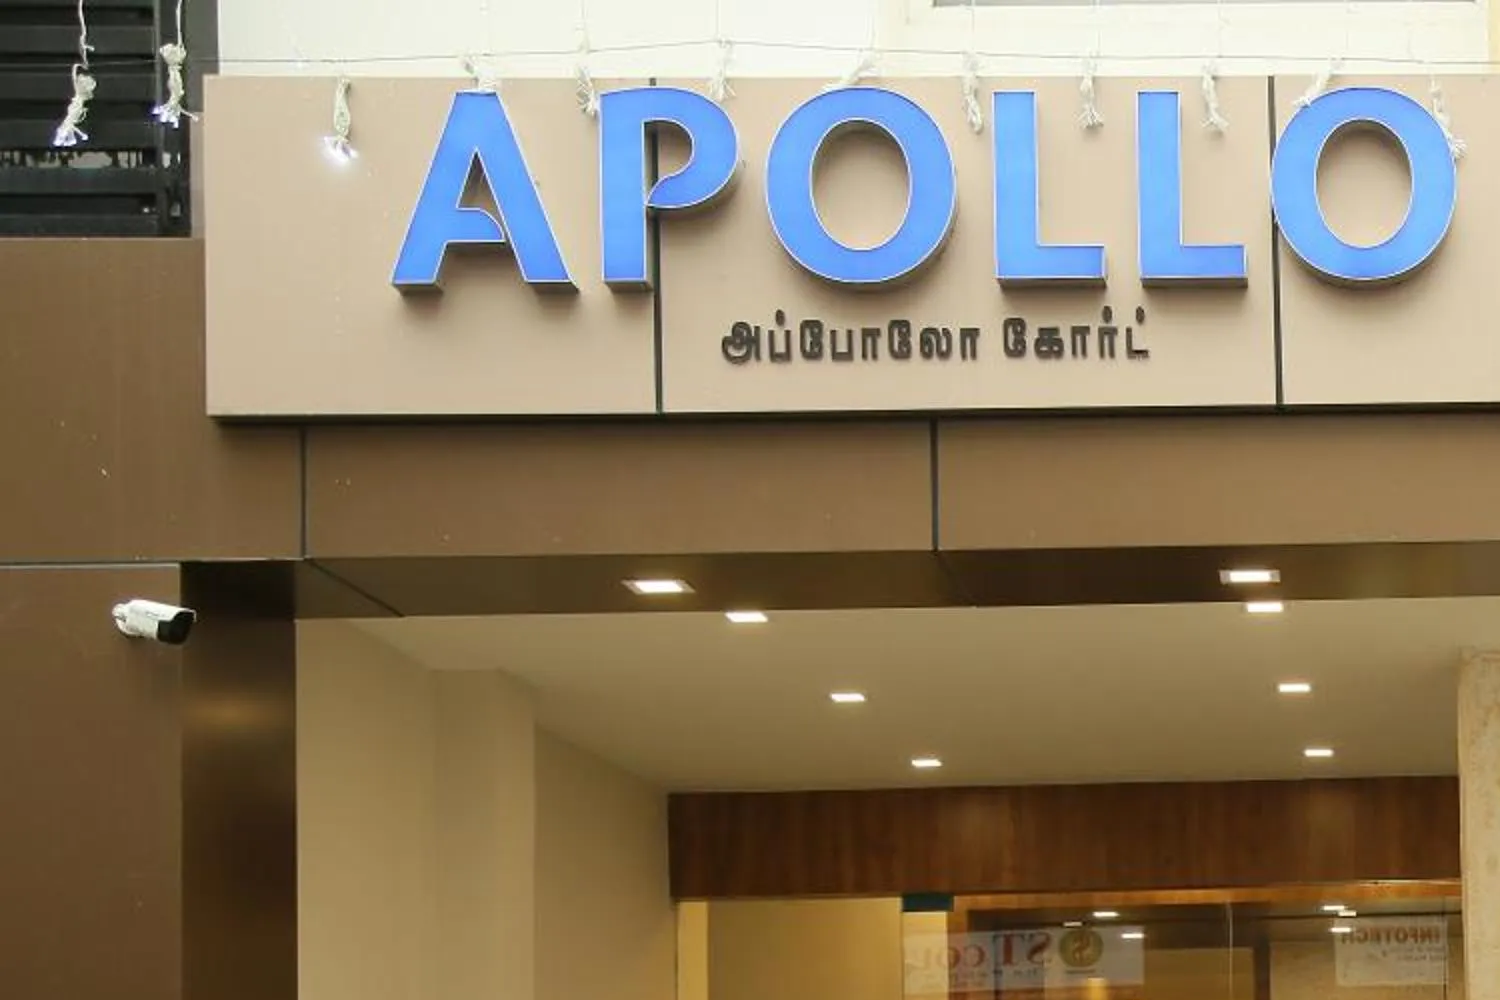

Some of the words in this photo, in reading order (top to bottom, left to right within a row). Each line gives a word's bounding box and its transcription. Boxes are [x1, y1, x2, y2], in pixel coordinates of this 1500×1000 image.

[392, 86, 1458, 290] APOLLO
[721, 308, 981, 365] அப்போலோ
[1002, 305, 1150, 361] கோர்ட்
